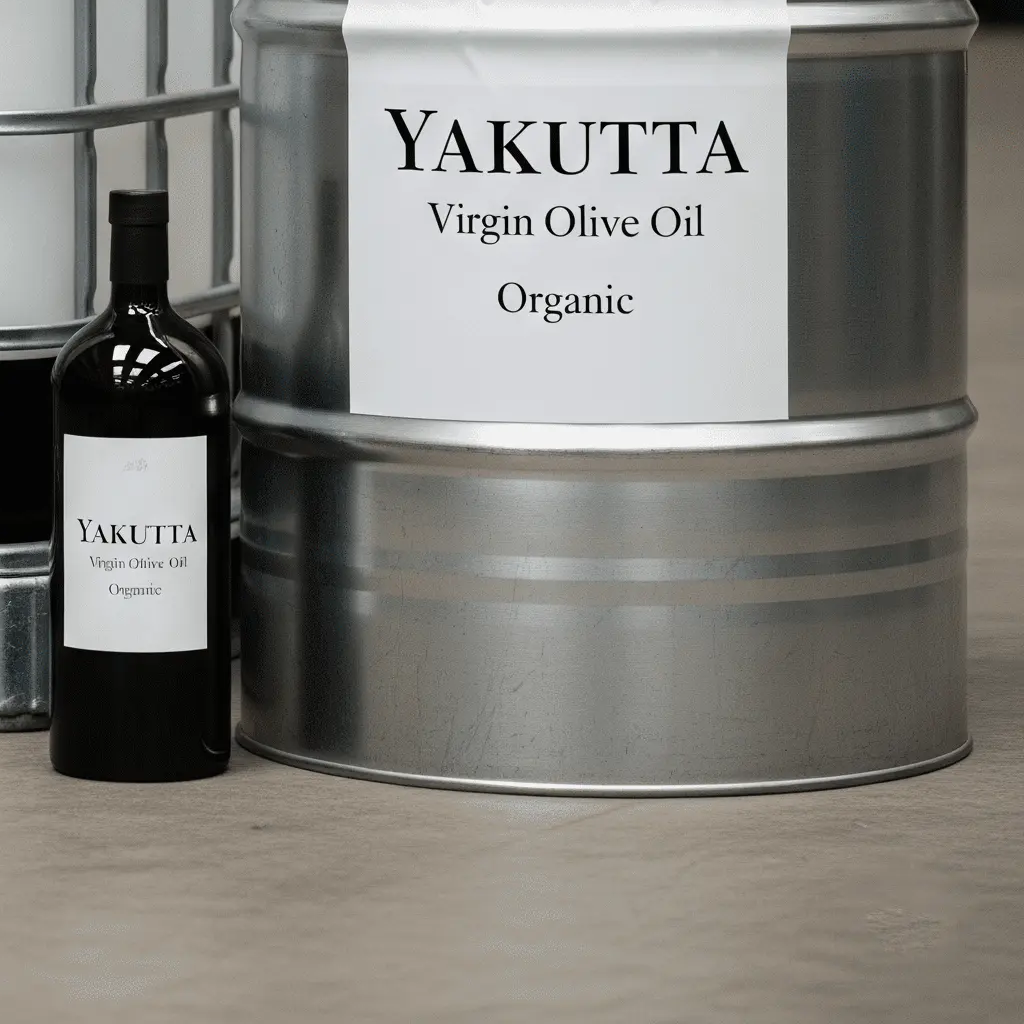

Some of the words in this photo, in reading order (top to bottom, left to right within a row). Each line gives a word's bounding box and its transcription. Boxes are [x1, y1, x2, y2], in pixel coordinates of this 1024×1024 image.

[384, 108, 750, 176] YAKUTTA
[428, 202, 534, 245] Virgin
[544, 204, 640, 238] Olive
[650, 203, 705, 238] Oil
[497, 282, 634, 325] Organic
[77, 518, 198, 545] YAKUTTA
[169, 556, 187, 569] Oil
